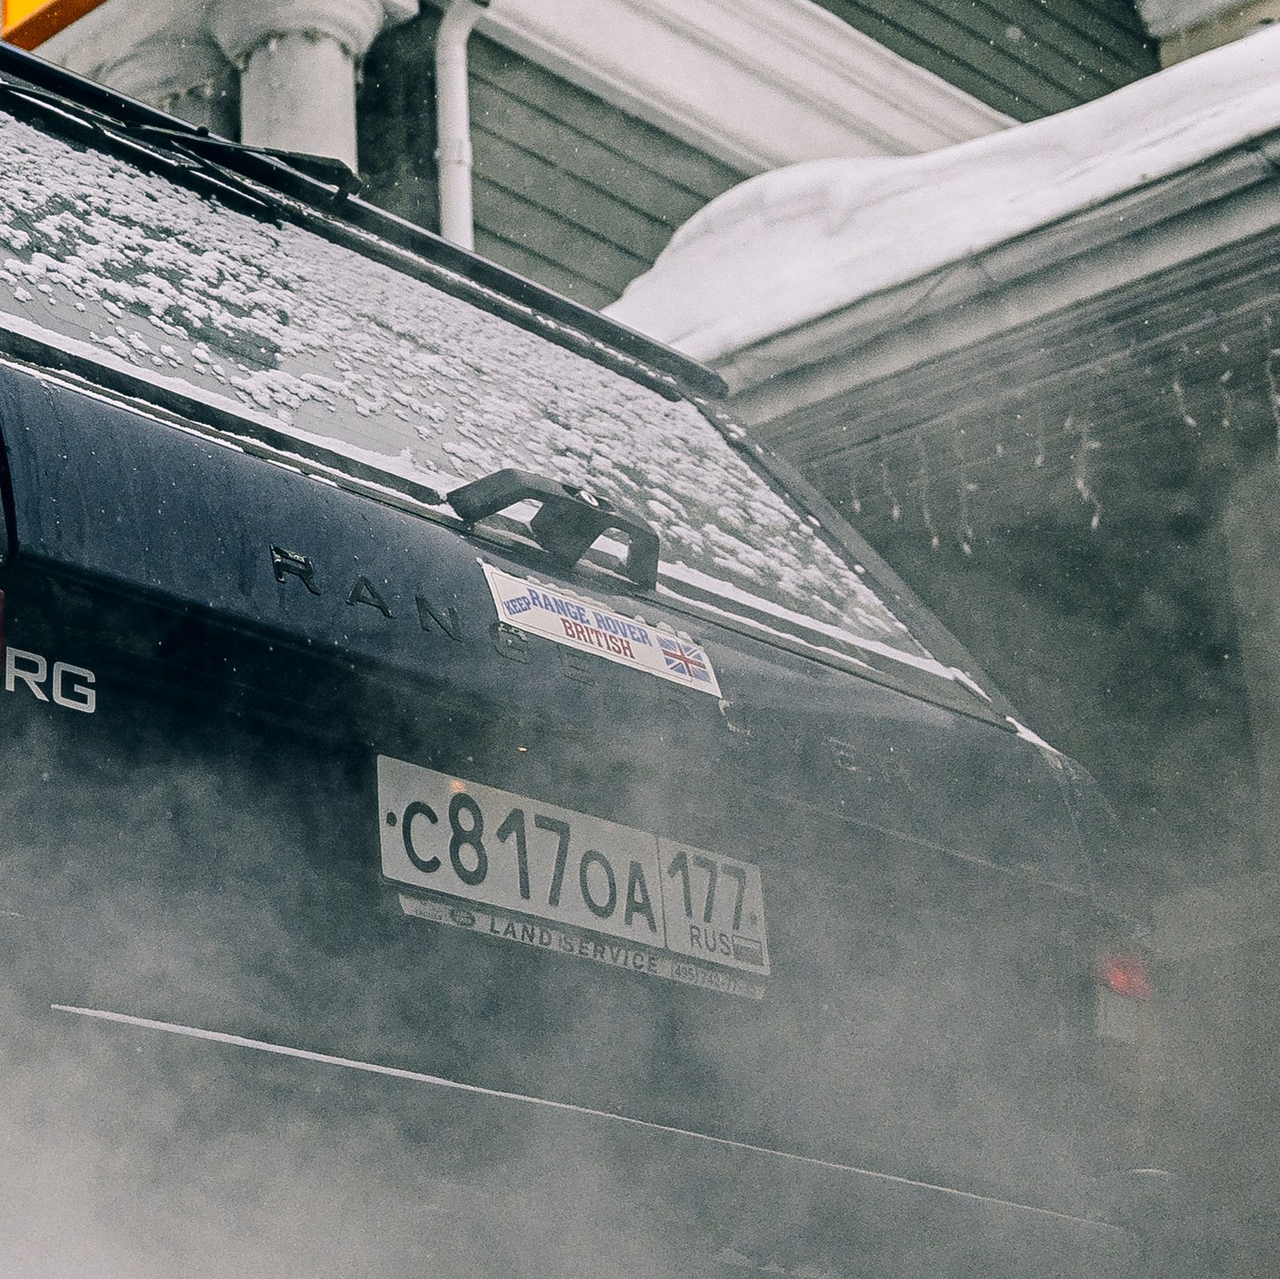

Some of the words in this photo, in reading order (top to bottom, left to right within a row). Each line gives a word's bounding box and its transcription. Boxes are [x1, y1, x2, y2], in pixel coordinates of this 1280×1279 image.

[503, 595, 533, 617] KEEP
[526, 587, 591, 626] RANGE
[592, 611, 654, 648] ROVER
[560, 617, 636, 660] BRITISH
[5, 645, 97, 714] RG
[666, 850, 748, 931] 177
[488, 915, 554, 947] LAND
[558, 932, 659, 976] SERVICE
[689, 924, 734, 958] RUS
